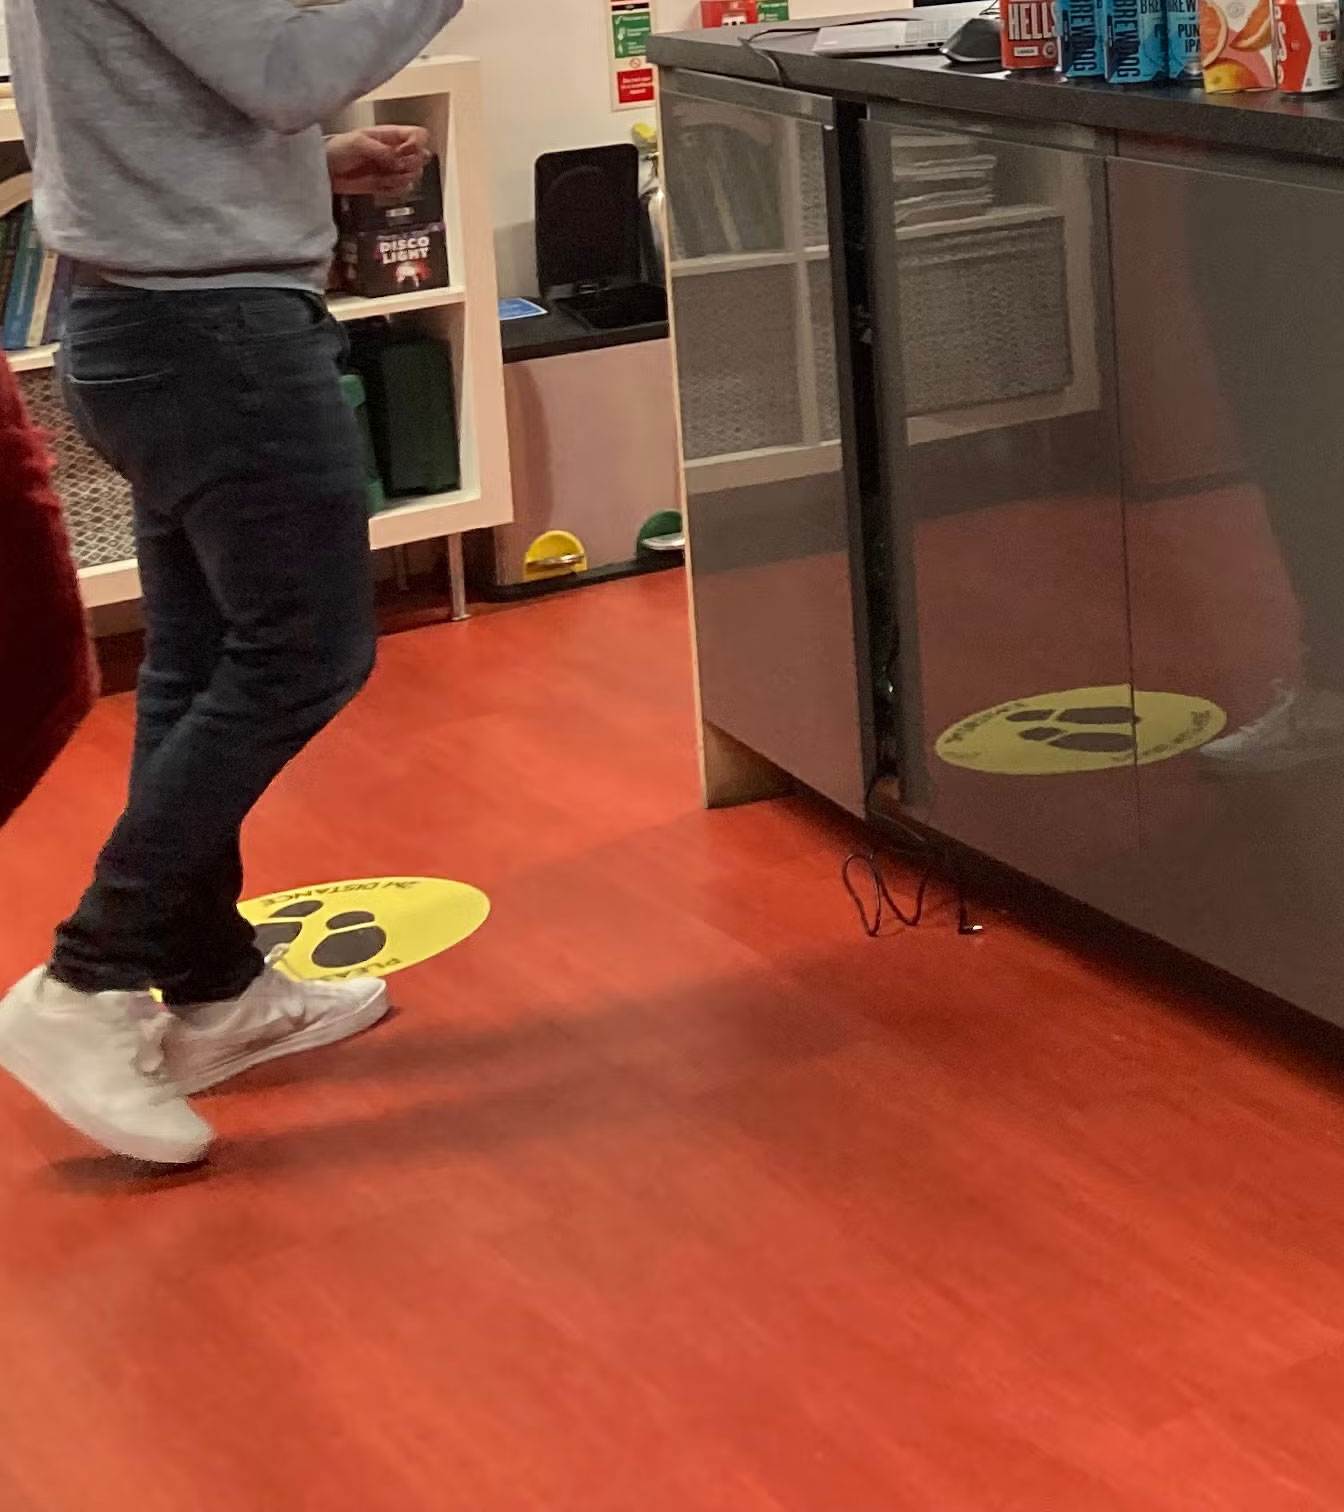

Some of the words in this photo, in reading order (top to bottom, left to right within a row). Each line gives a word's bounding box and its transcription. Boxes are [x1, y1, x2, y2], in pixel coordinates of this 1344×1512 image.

[1178, 23, 1200, 38] PUN
[379, 236, 430, 253] DISCO
[382, 246, 430, 265] LIGHT
[261, 881, 378, 907] DISTANCE
